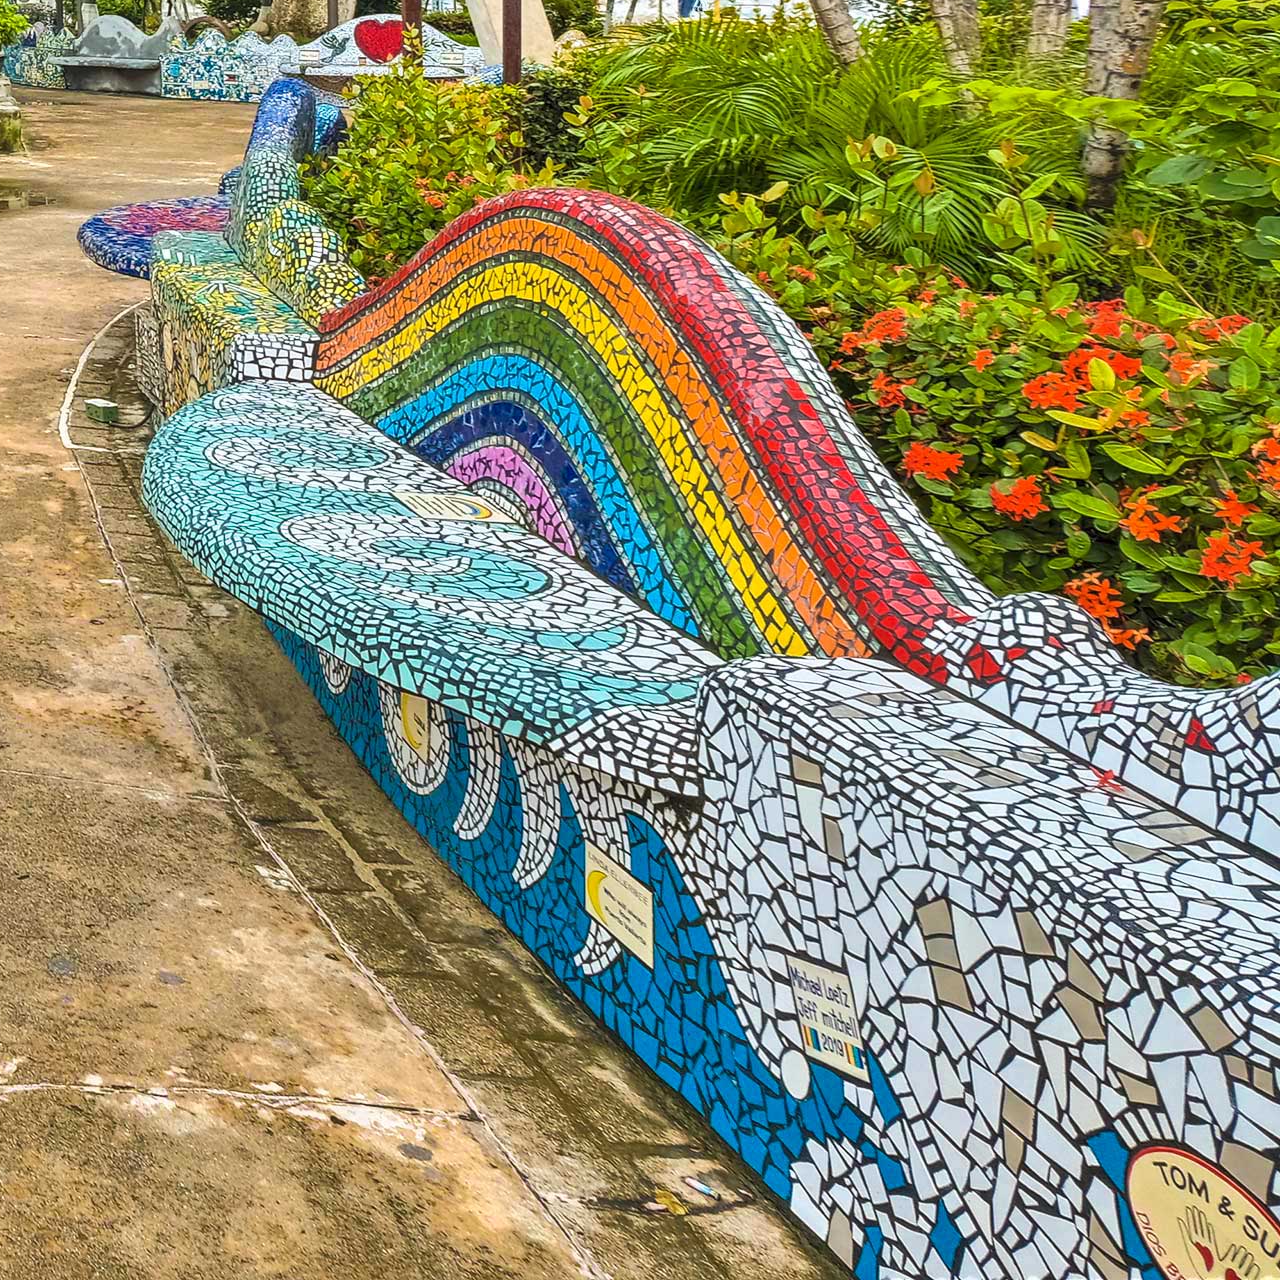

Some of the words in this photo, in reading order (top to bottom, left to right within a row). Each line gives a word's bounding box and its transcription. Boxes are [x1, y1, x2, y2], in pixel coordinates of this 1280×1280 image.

[789, 966, 823, 998] Michael
[797, 996, 818, 1023] Jeff
[821, 1032, 845, 1057] 2019
[1152, 1161, 1210, 1204] TOM
[1218, 1195, 1235, 1221] &
[1242, 1214, 1280, 1269] SU
[1136, 1211, 1167, 1257] DIOS
